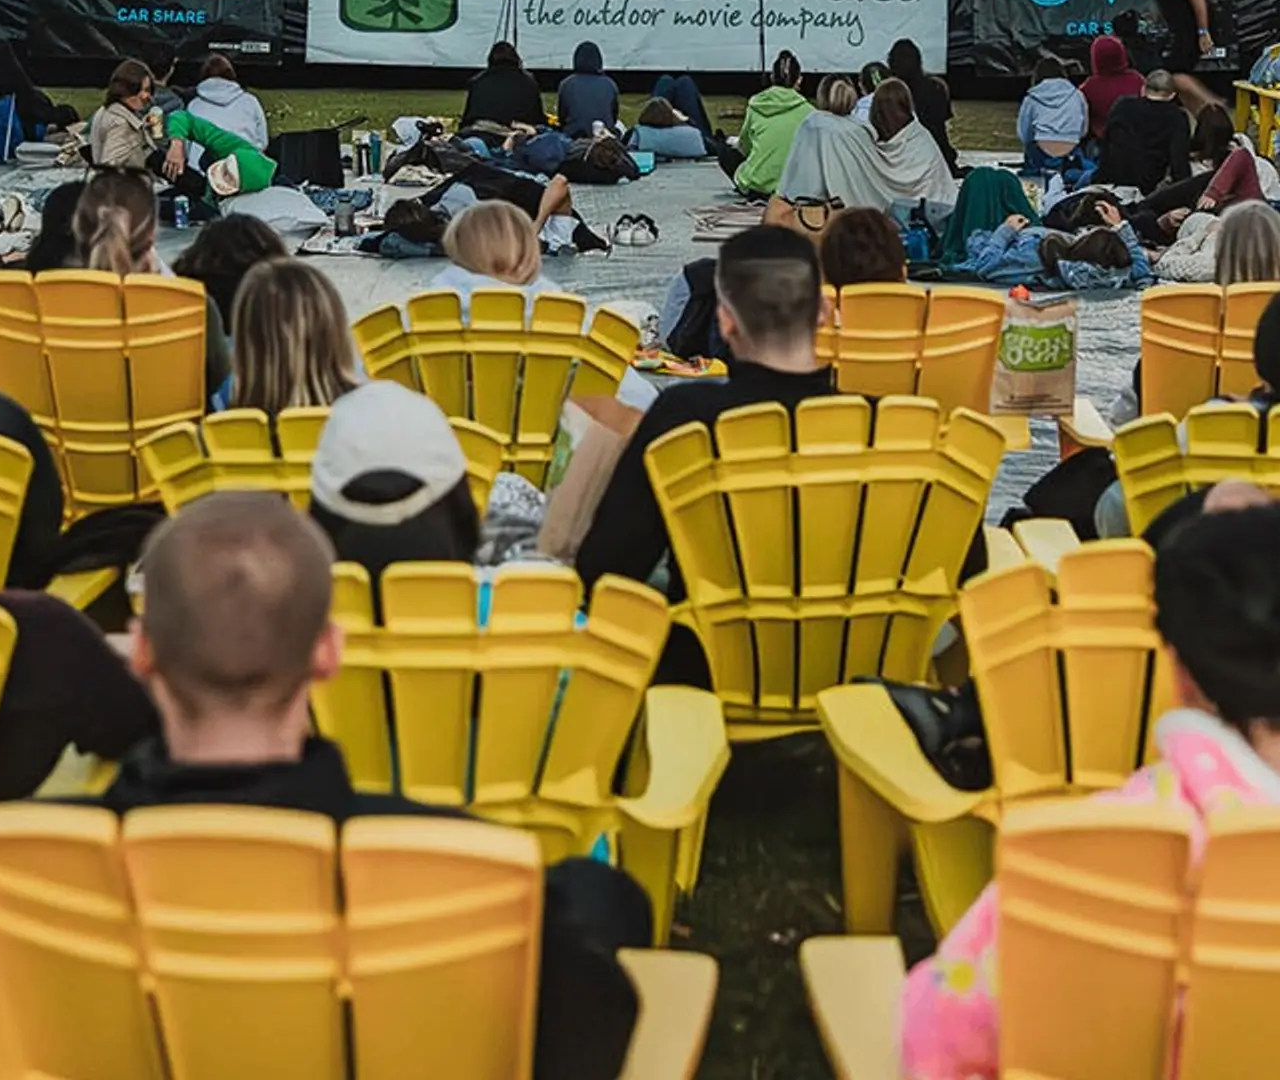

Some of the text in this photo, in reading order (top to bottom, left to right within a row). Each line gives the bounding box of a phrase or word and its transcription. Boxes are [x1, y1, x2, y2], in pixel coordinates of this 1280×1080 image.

[118, 8, 207, 24] CAR SHARE
[674, 3, 743, 28] movie
[750, 6, 864, 47] company
[1066, 21, 1098, 36] CAR
